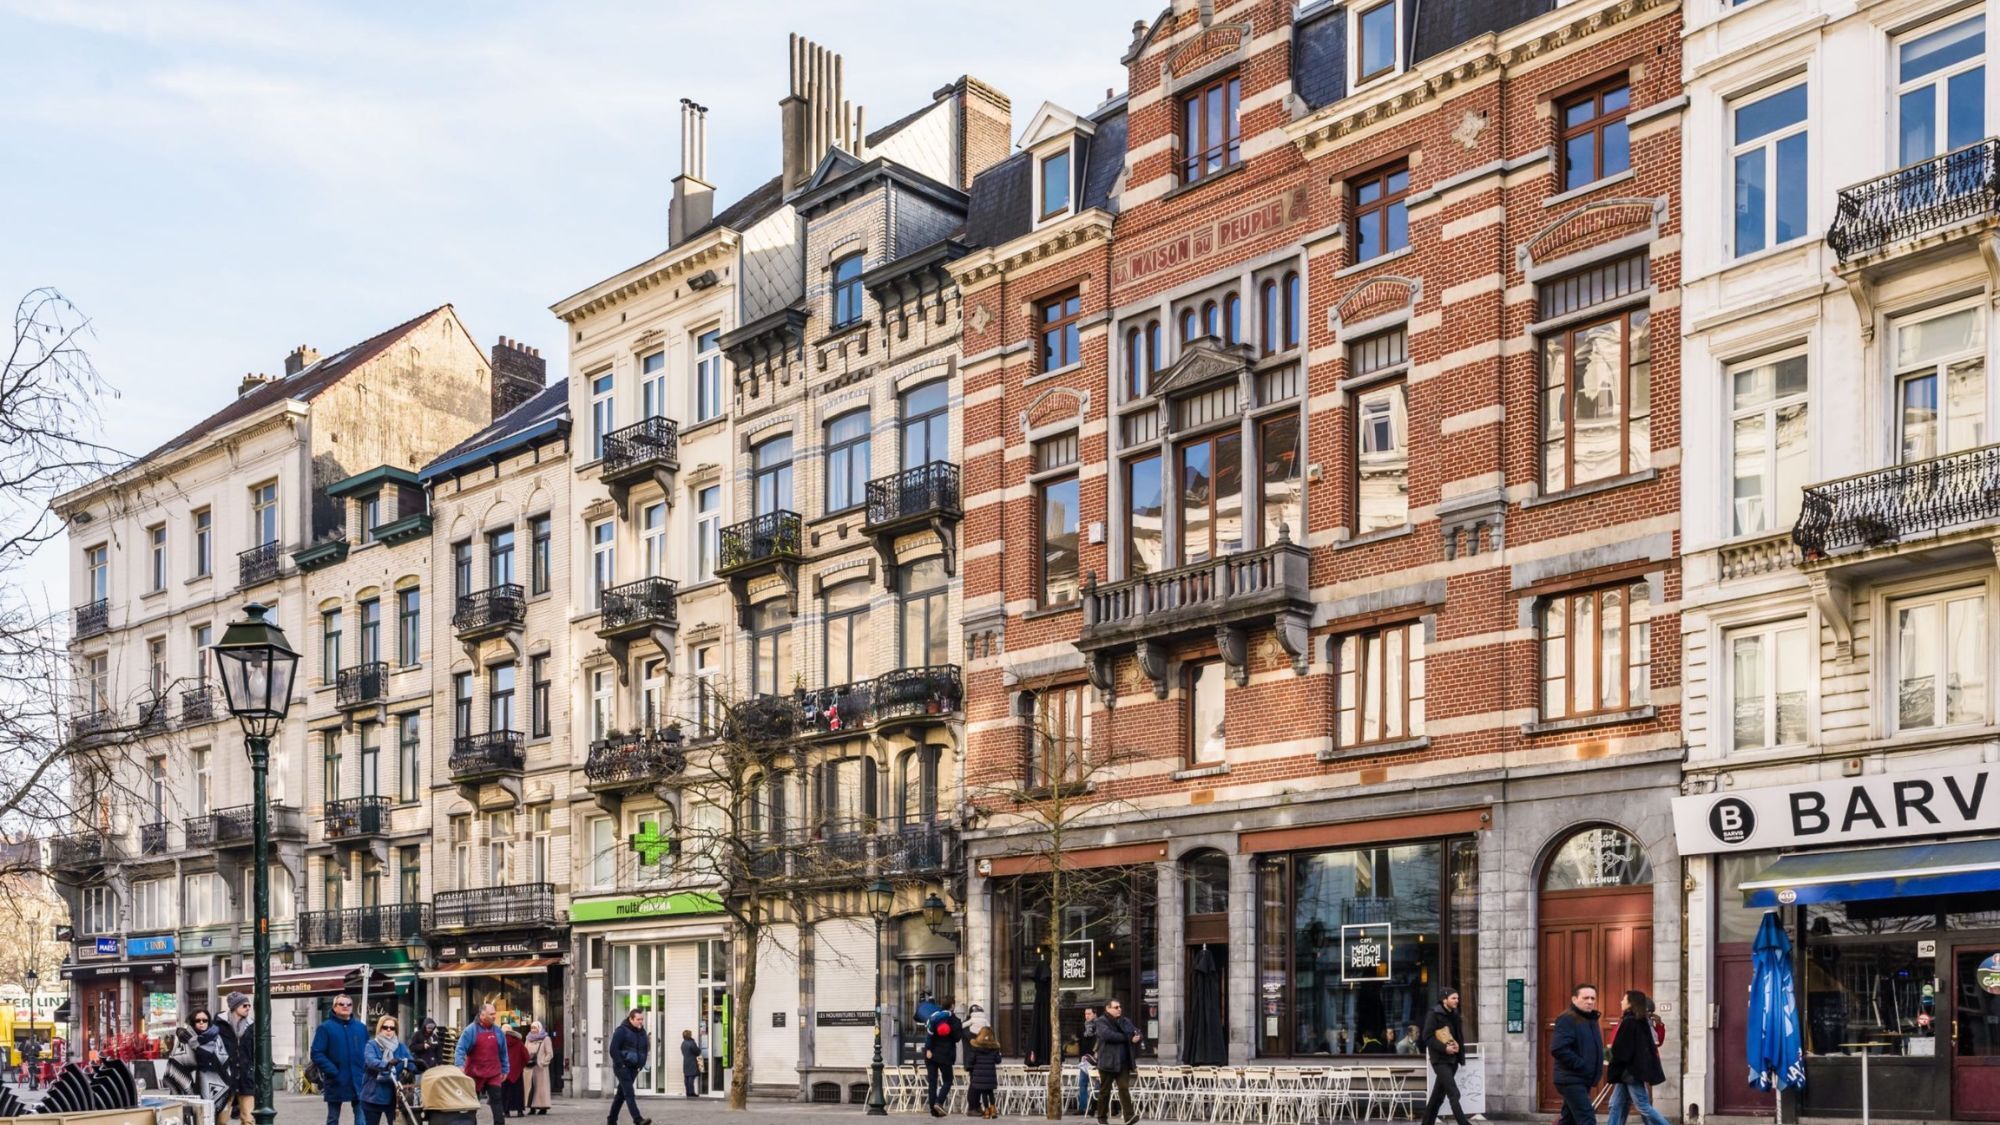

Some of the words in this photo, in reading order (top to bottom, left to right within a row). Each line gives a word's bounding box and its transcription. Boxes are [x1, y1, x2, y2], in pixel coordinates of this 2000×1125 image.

[1113, 266, 1128, 286] LA
[1131, 239, 1189, 279] MAISON
[1195, 236, 1211, 253] DU
[1220, 204, 1282, 244] PEUPLE
[1789, 772, 1989, 836] BARV
[1720, 805, 1743, 831] B
[1576, 876, 1620, 885] VOLKSHUIS
[1352, 944, 1380, 957] MAISON
[1063, 958, 1086, 968] MAISON
[1352, 956, 1381, 967] PEUPLE
[1063, 967, 1086, 978] PEUPLE
